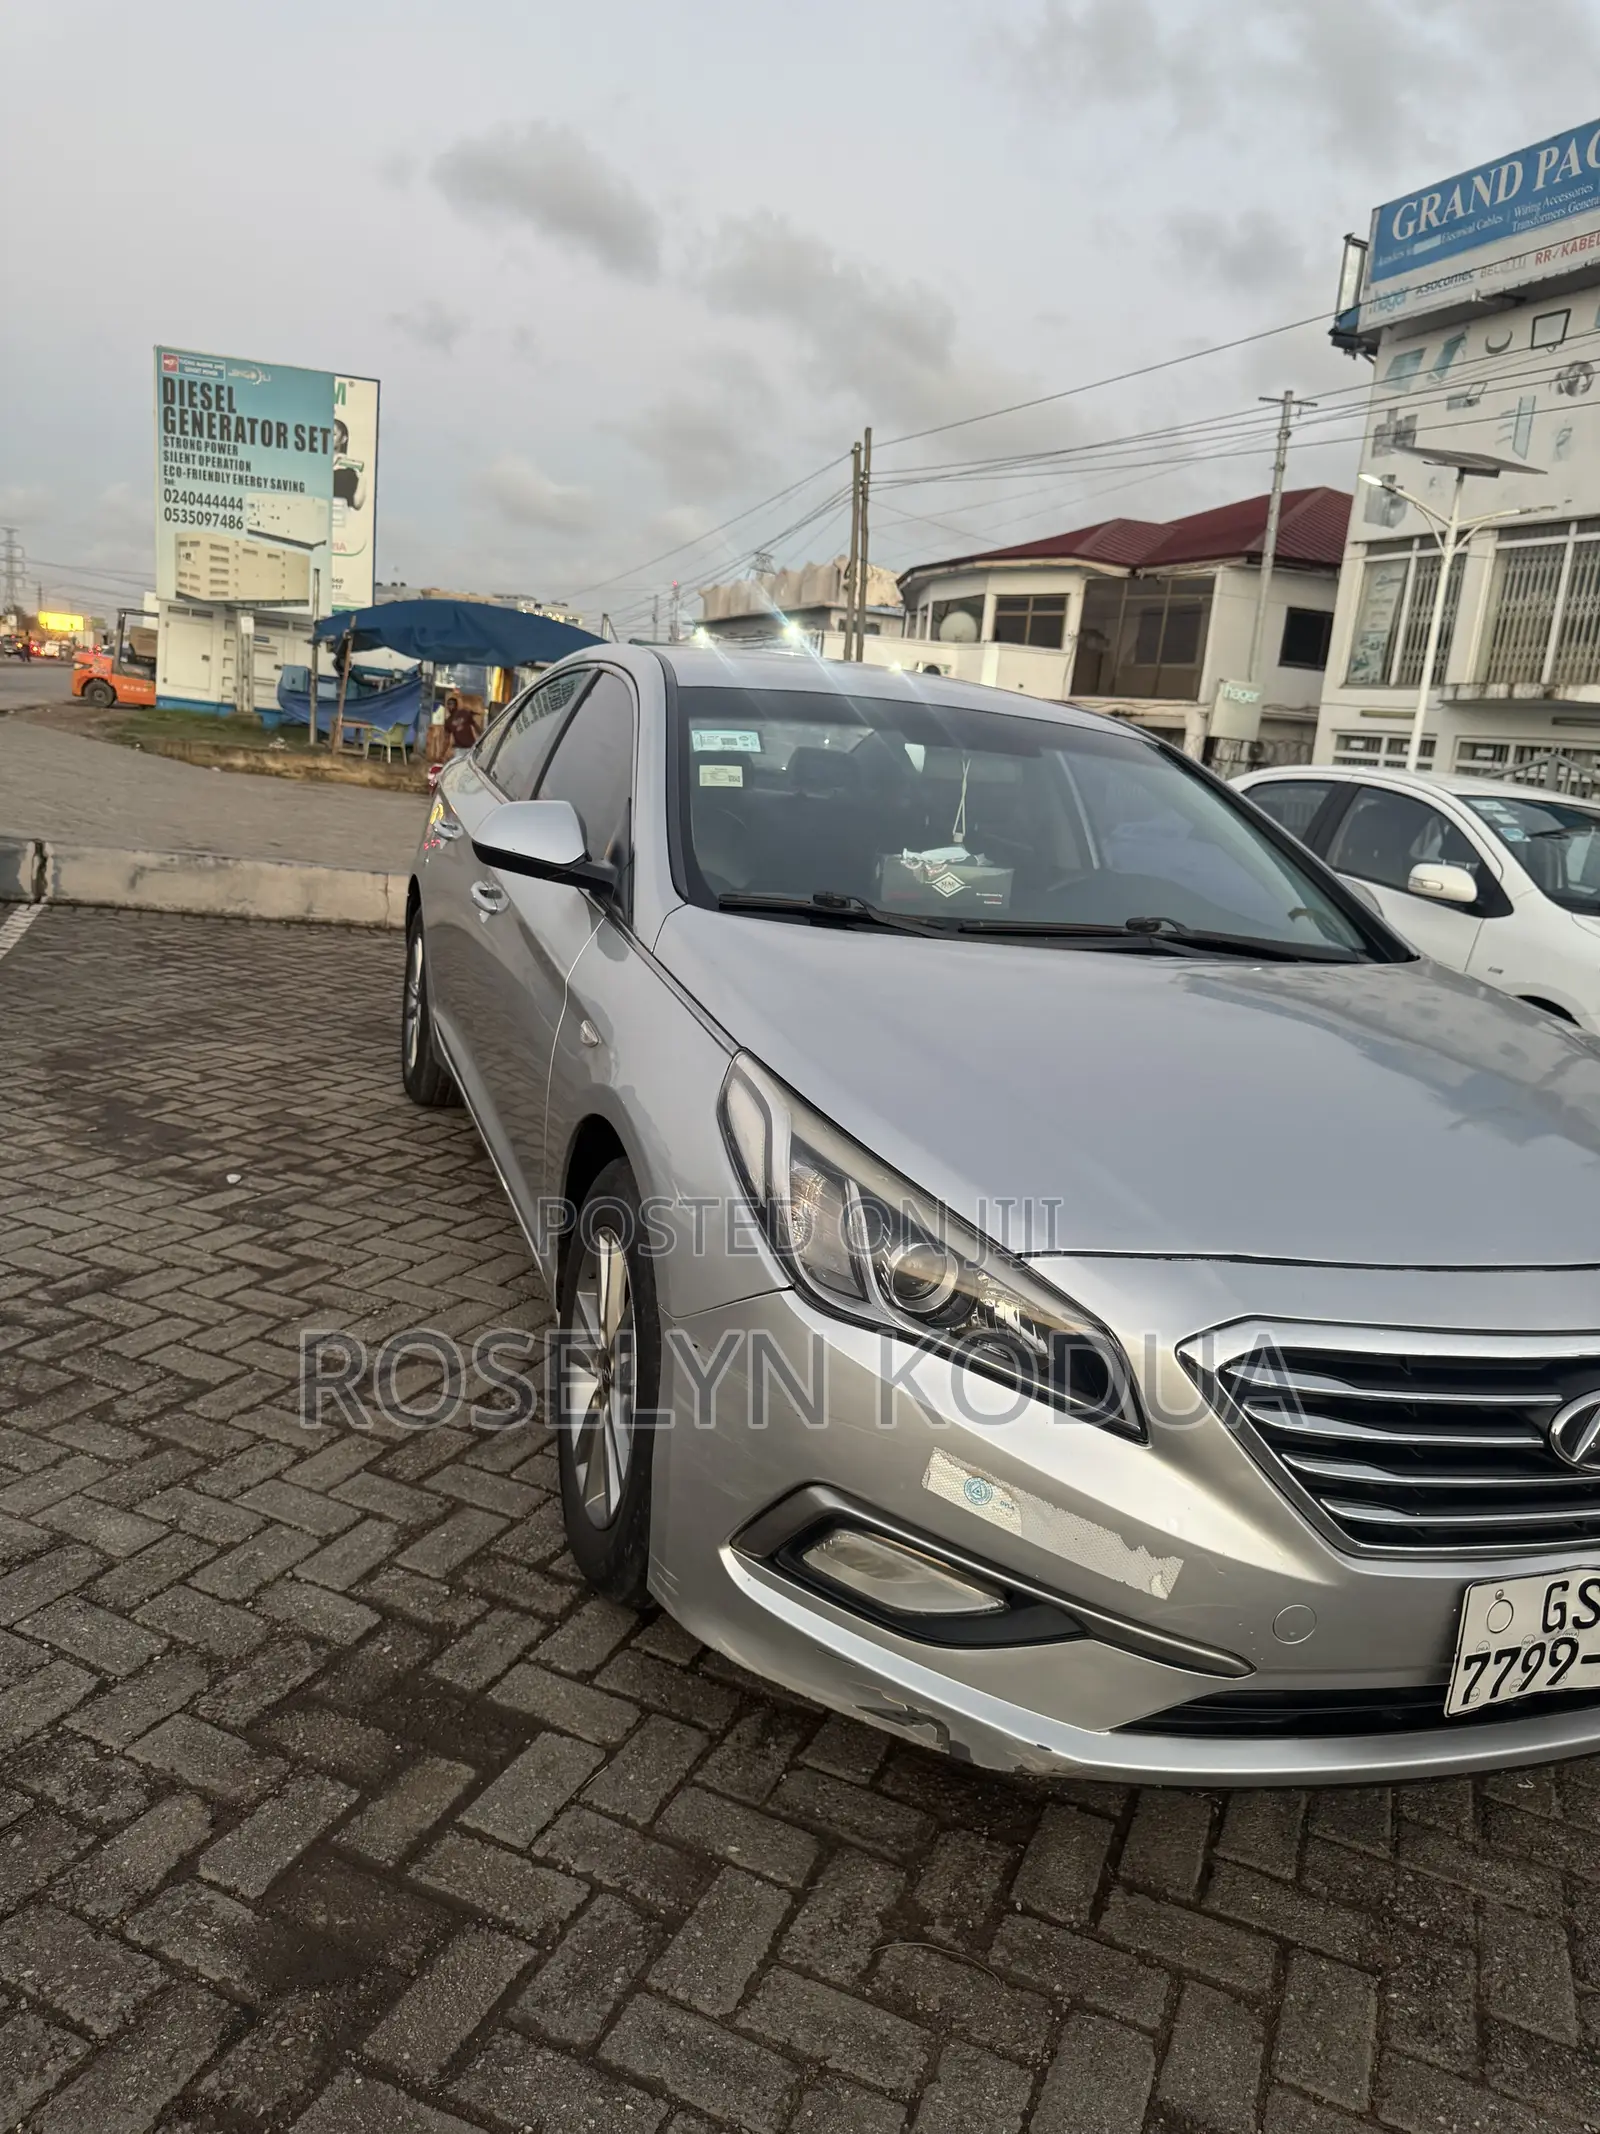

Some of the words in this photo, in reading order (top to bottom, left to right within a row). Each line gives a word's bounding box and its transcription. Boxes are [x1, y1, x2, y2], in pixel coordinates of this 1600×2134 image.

[1392, 160, 1524, 241] GRAND
[162, 376, 237, 414] DIESEL
[162, 406, 288, 450] GENERATOR
[294, 423, 332, 455] SET
[163, 436, 202, 451] STRONG
[204, 441, 238, 456] POWER
[163, 450, 196, 465] SILENT
[198, 454, 251, 472] OPERATION
[163, 464, 231, 484] ECO-FRIENDLY
[233, 474, 269, 489] ENERGY
[270, 478, 305, 493] SAVING
[164, 488, 243, 512] 0240444444
[164, 507, 244, 530] 0535097486
[1224, 683, 1260, 704] hager
[1541, 1577, 1600, 1634] GS
